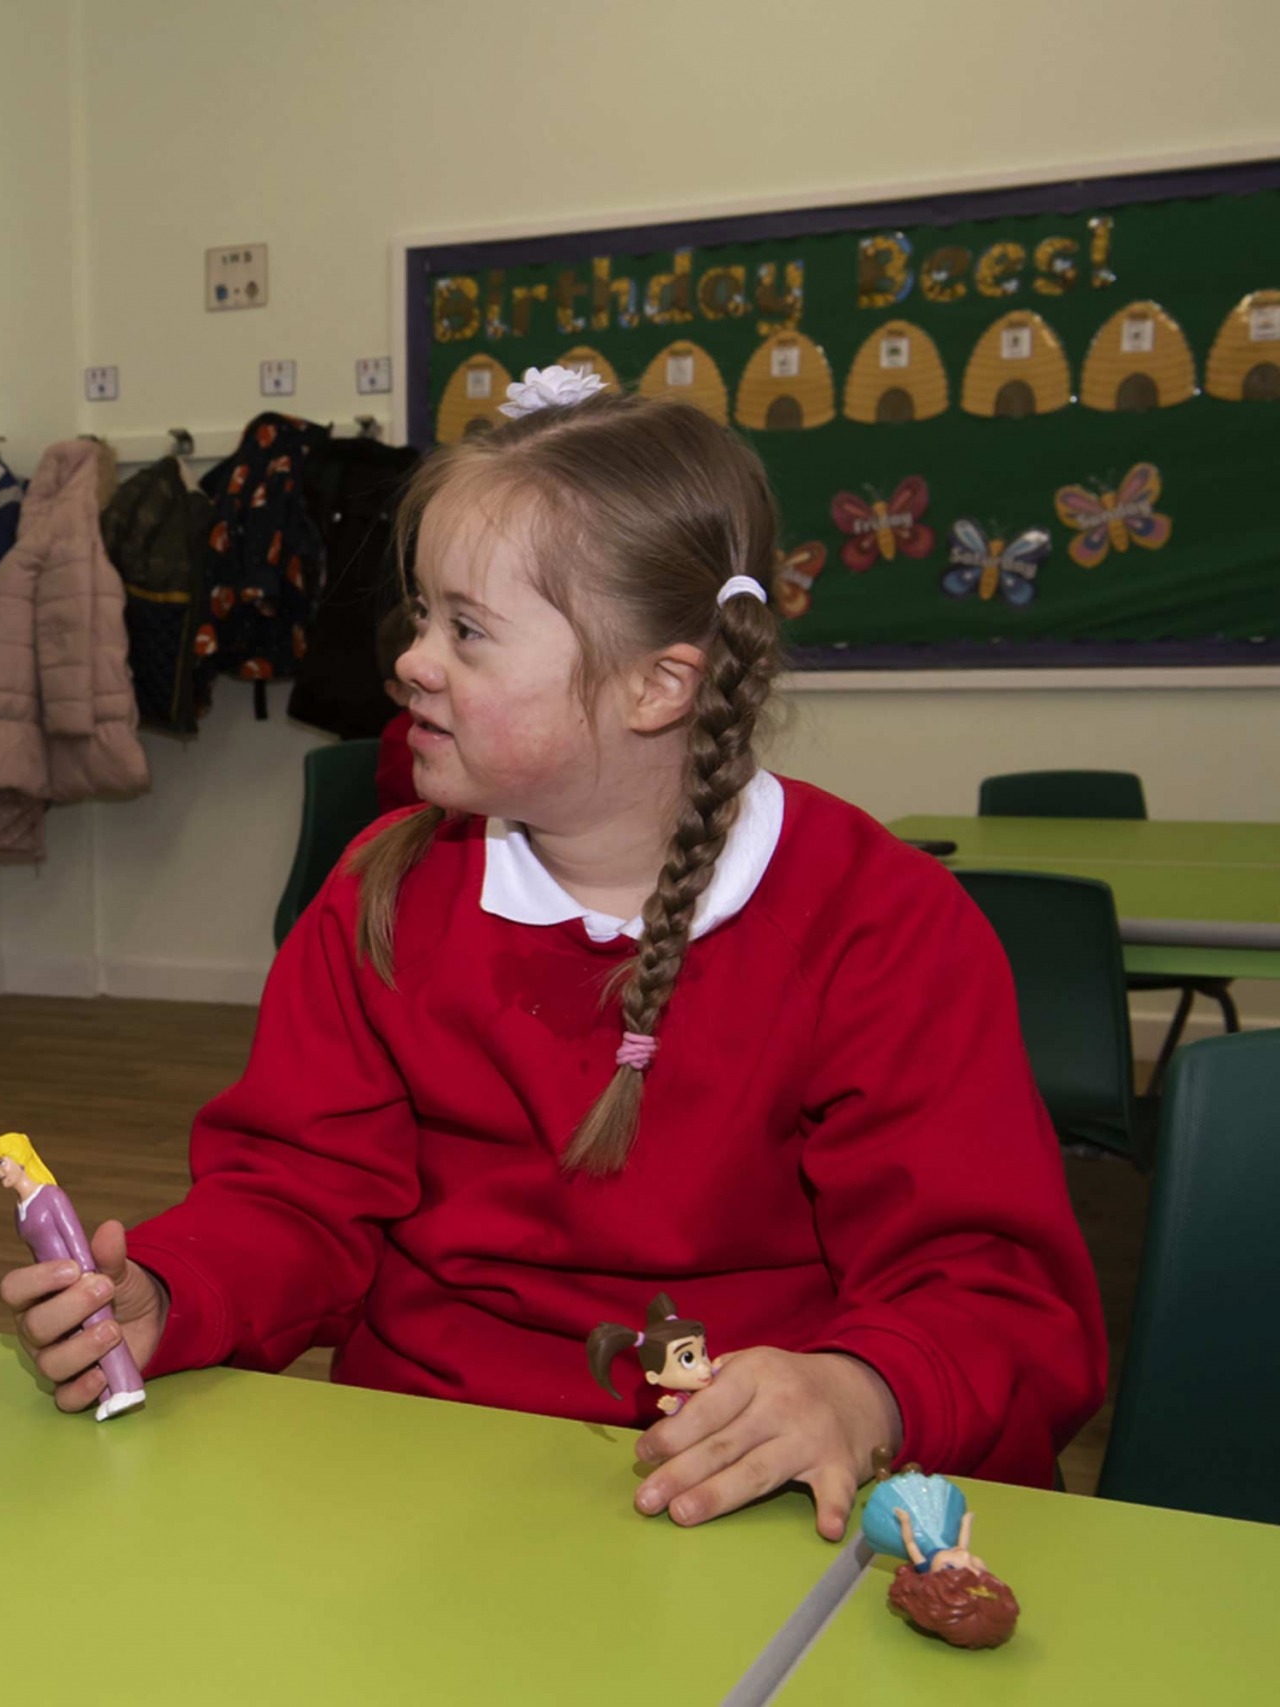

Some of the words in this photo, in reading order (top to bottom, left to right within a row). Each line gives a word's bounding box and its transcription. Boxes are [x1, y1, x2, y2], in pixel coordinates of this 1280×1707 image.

[433, 247, 805, 342] Birthday
[857, 216, 1116, 309] Bees!
[852, 509, 913, 535] Friday
[948, 547, 1038, 580] Saturday
